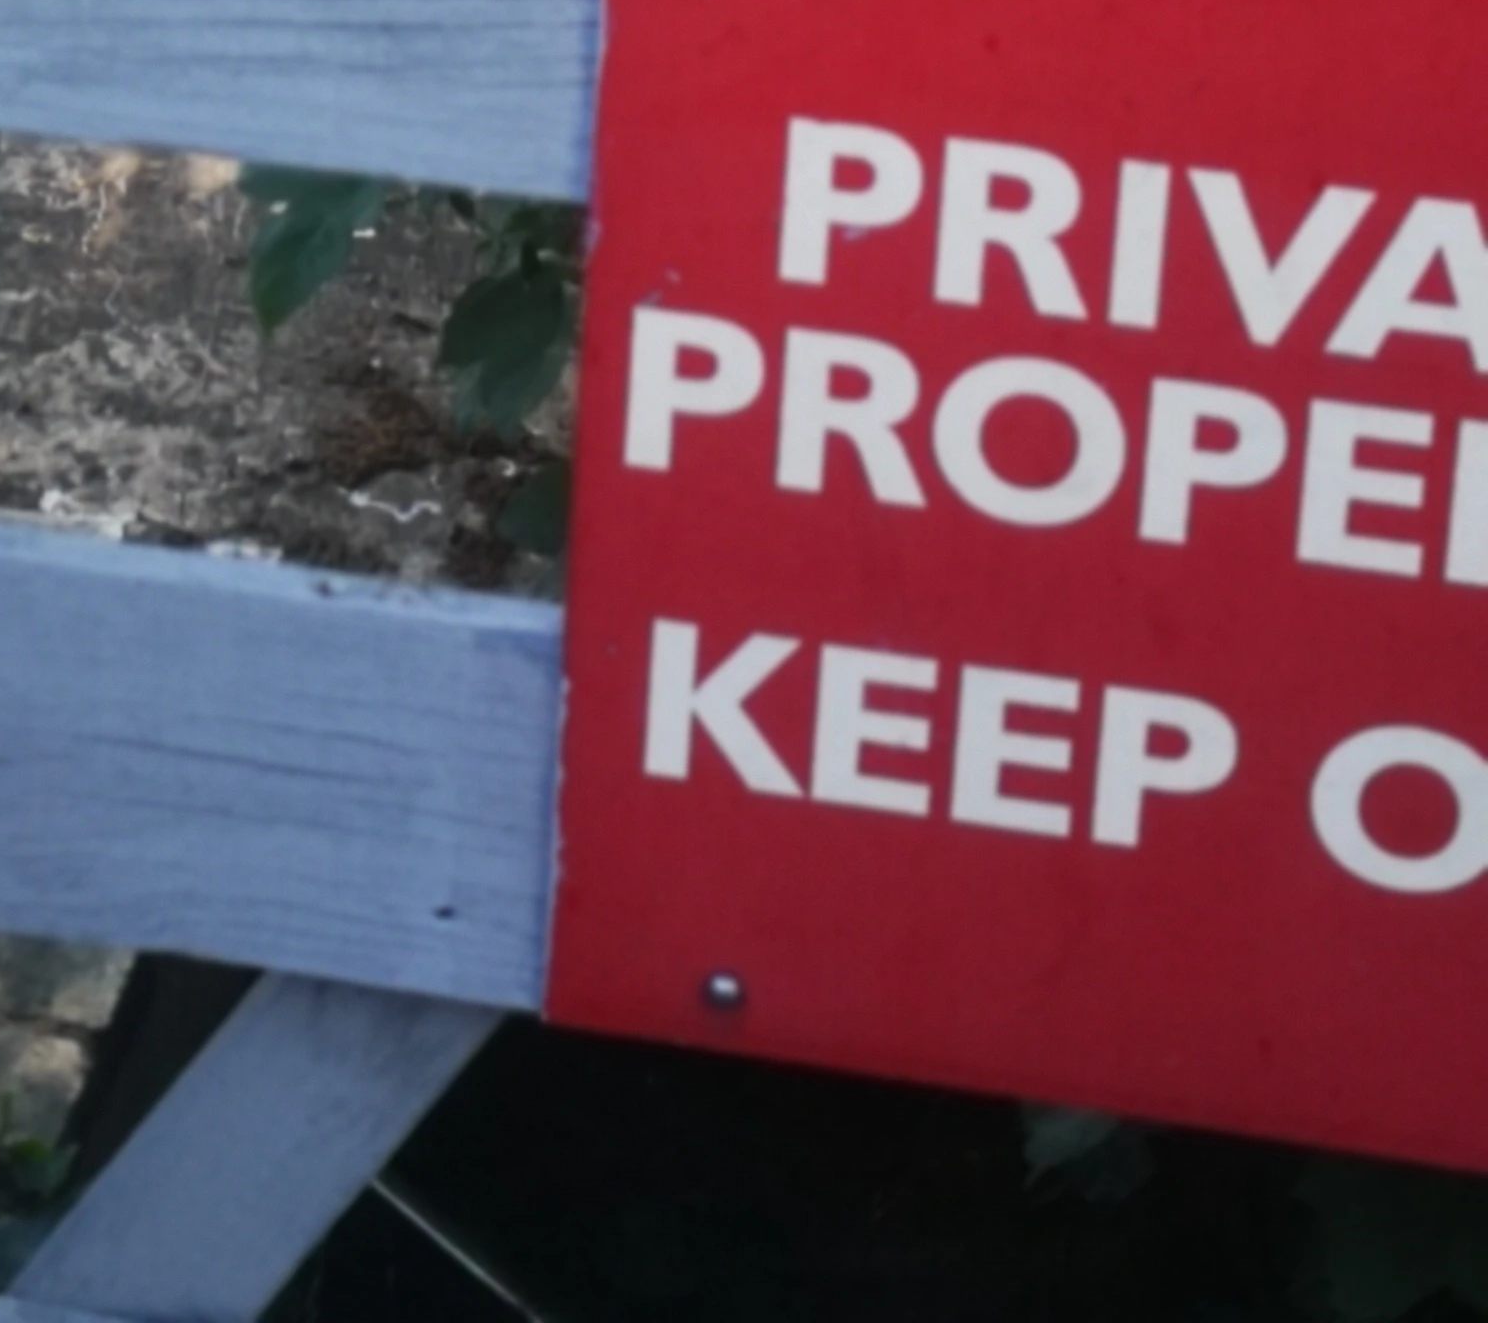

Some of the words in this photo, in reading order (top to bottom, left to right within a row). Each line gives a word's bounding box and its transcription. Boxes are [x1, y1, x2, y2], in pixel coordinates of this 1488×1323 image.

[777, 115, 1488, 375] PRIVA
[622, 304, 1488, 588] PROPE
[643, 617, 1239, 848] KEEP
